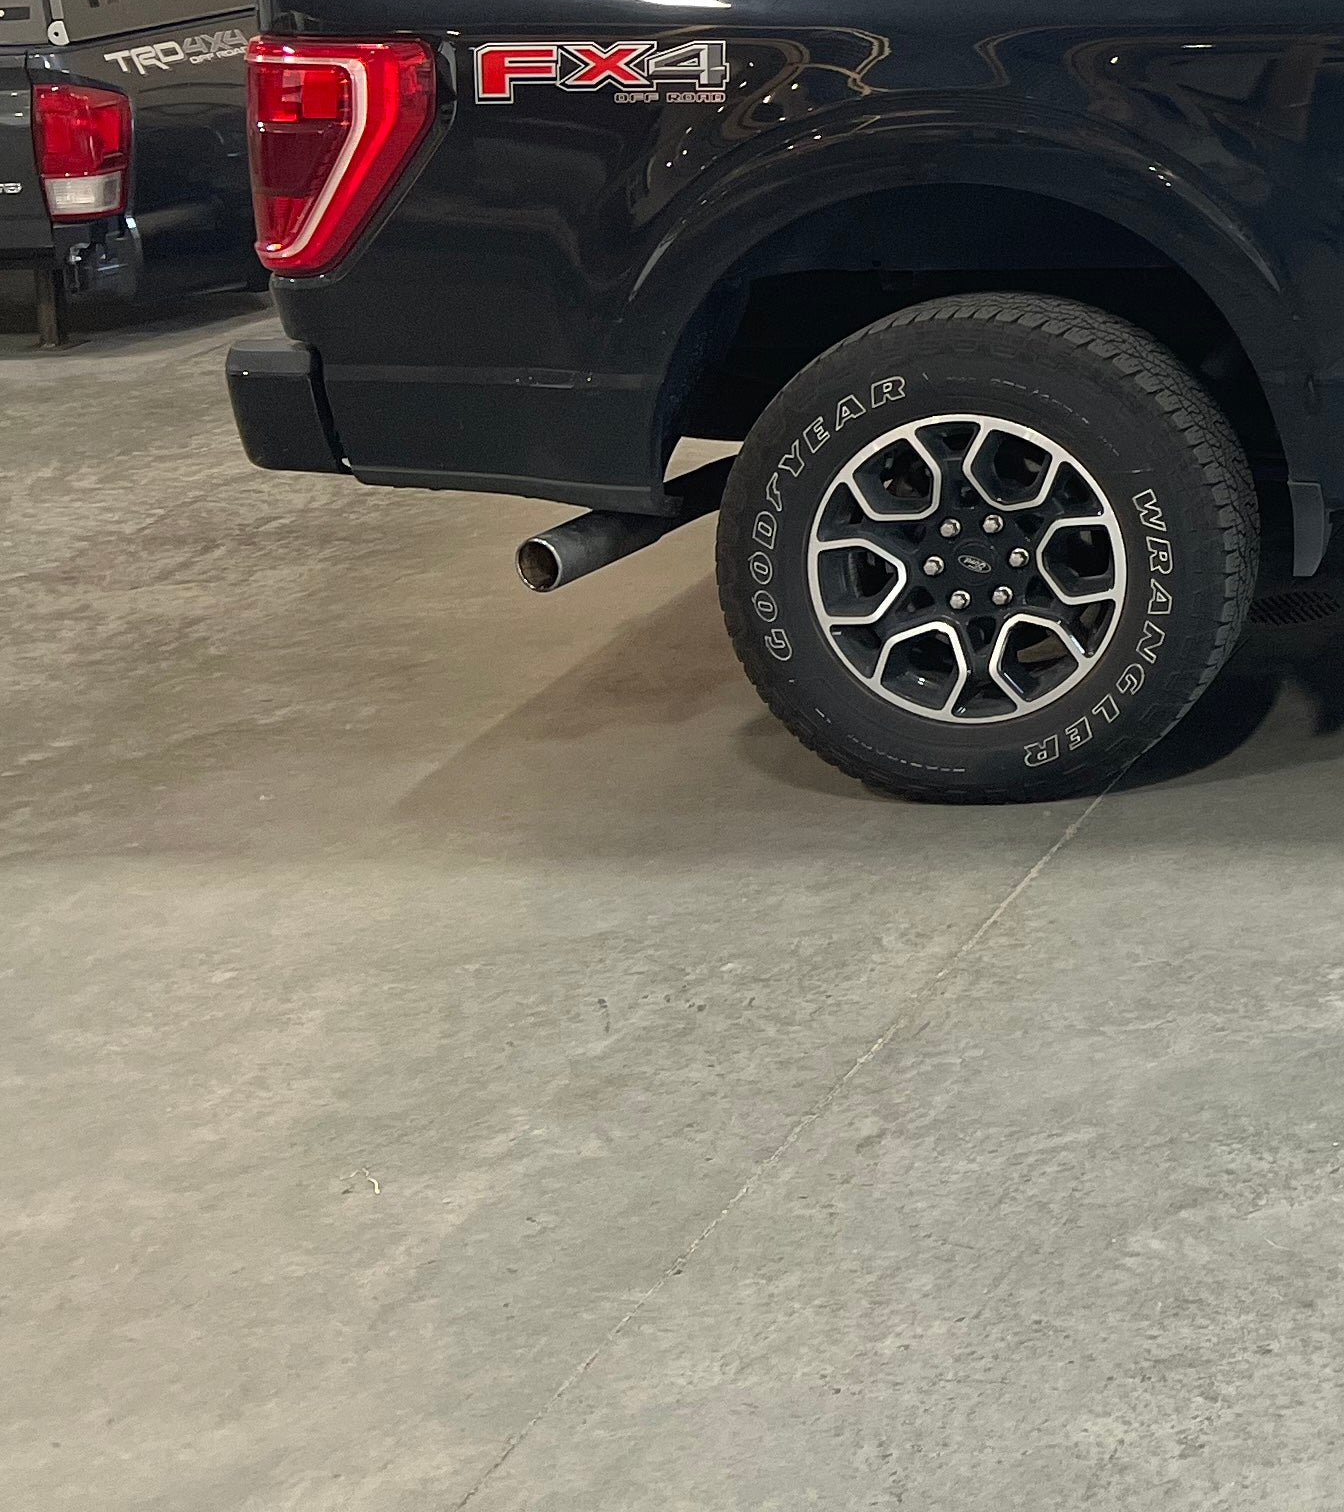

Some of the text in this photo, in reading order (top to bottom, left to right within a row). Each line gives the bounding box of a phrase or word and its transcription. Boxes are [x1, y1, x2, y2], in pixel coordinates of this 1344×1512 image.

[103, 40, 185, 76] TRD
[190, 52, 214, 64] OFF
[474, 41, 729, 104] FX4
[614, 92, 726, 104] OFF ROAD
[748, 376, 906, 661] GOODYEAR
[1024, 489, 1173, 767] WRANGLER
